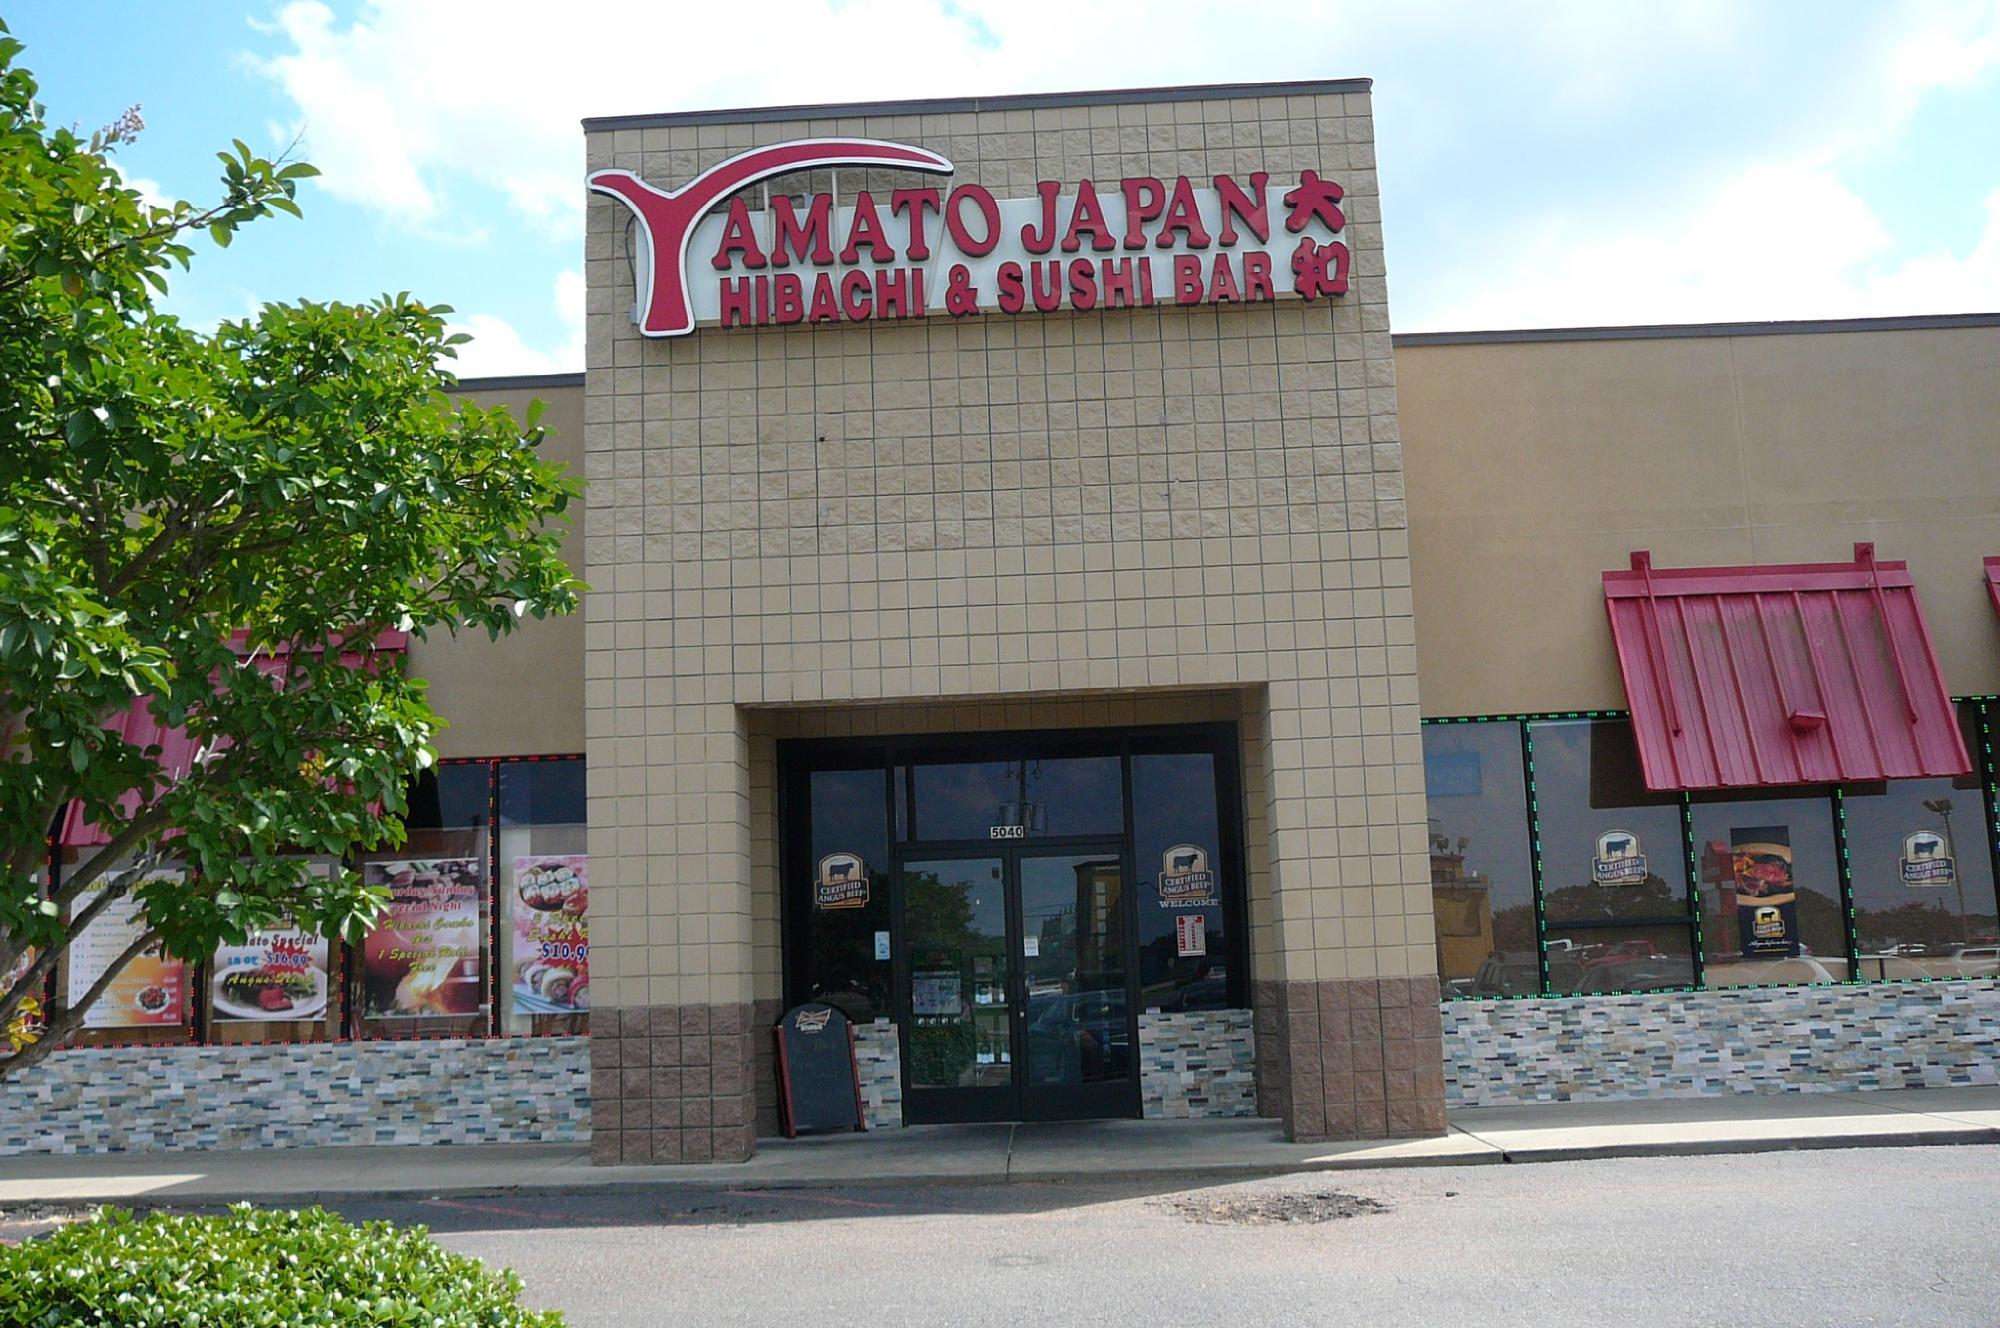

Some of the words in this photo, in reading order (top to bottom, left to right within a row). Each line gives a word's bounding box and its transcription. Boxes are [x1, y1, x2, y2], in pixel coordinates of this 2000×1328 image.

[585, 137, 1000, 338] YAMATO
[1021, 171, 1270, 254] JAPAN
[720, 267, 926, 329] HIBACHI
[945, 264, 978, 317] &
[997, 256, 1154, 314] SUSHI
[1174, 251, 1274, 305] BAR
[992, 827, 1023, 837] 5040
[1598, 859, 1640, 871] CERTIFIED
[1905, 860, 1947, 872] CERTIFIED
[1165, 873, 1205, 885] CERTIFIED
[1597, 870, 1624, 879] ANGUS
[821, 882, 861, 894] CERTIFIED
[1163, 885, 1190, 895] ANGUS
[818, 893, 845, 902] ANGUS
[1159, 899, 1218, 908] WELCOME
[267, 952, 308, 966] $16.99
